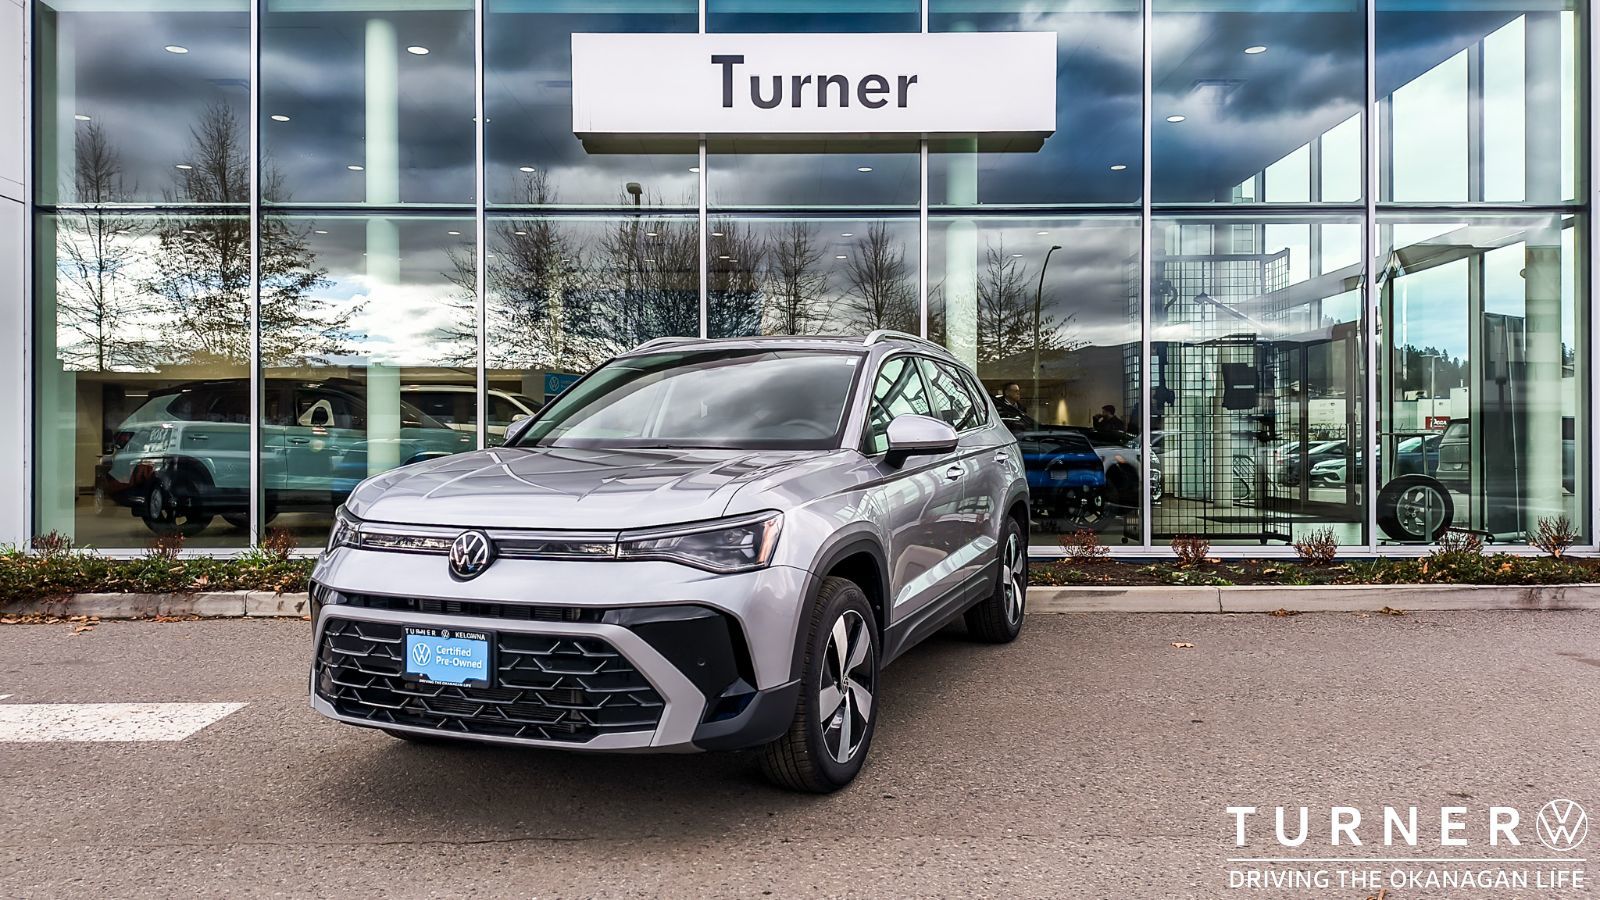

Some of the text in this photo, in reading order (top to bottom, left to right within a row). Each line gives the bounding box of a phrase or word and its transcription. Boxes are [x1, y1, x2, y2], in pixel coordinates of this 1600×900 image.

[710, 54, 918, 110] Turner
[405, 627, 437, 636] TURNER
[455, 631, 486, 641] KELOWNA
[436, 645, 471, 657] Certified
[435, 656, 482, 669] Pre-Owned
